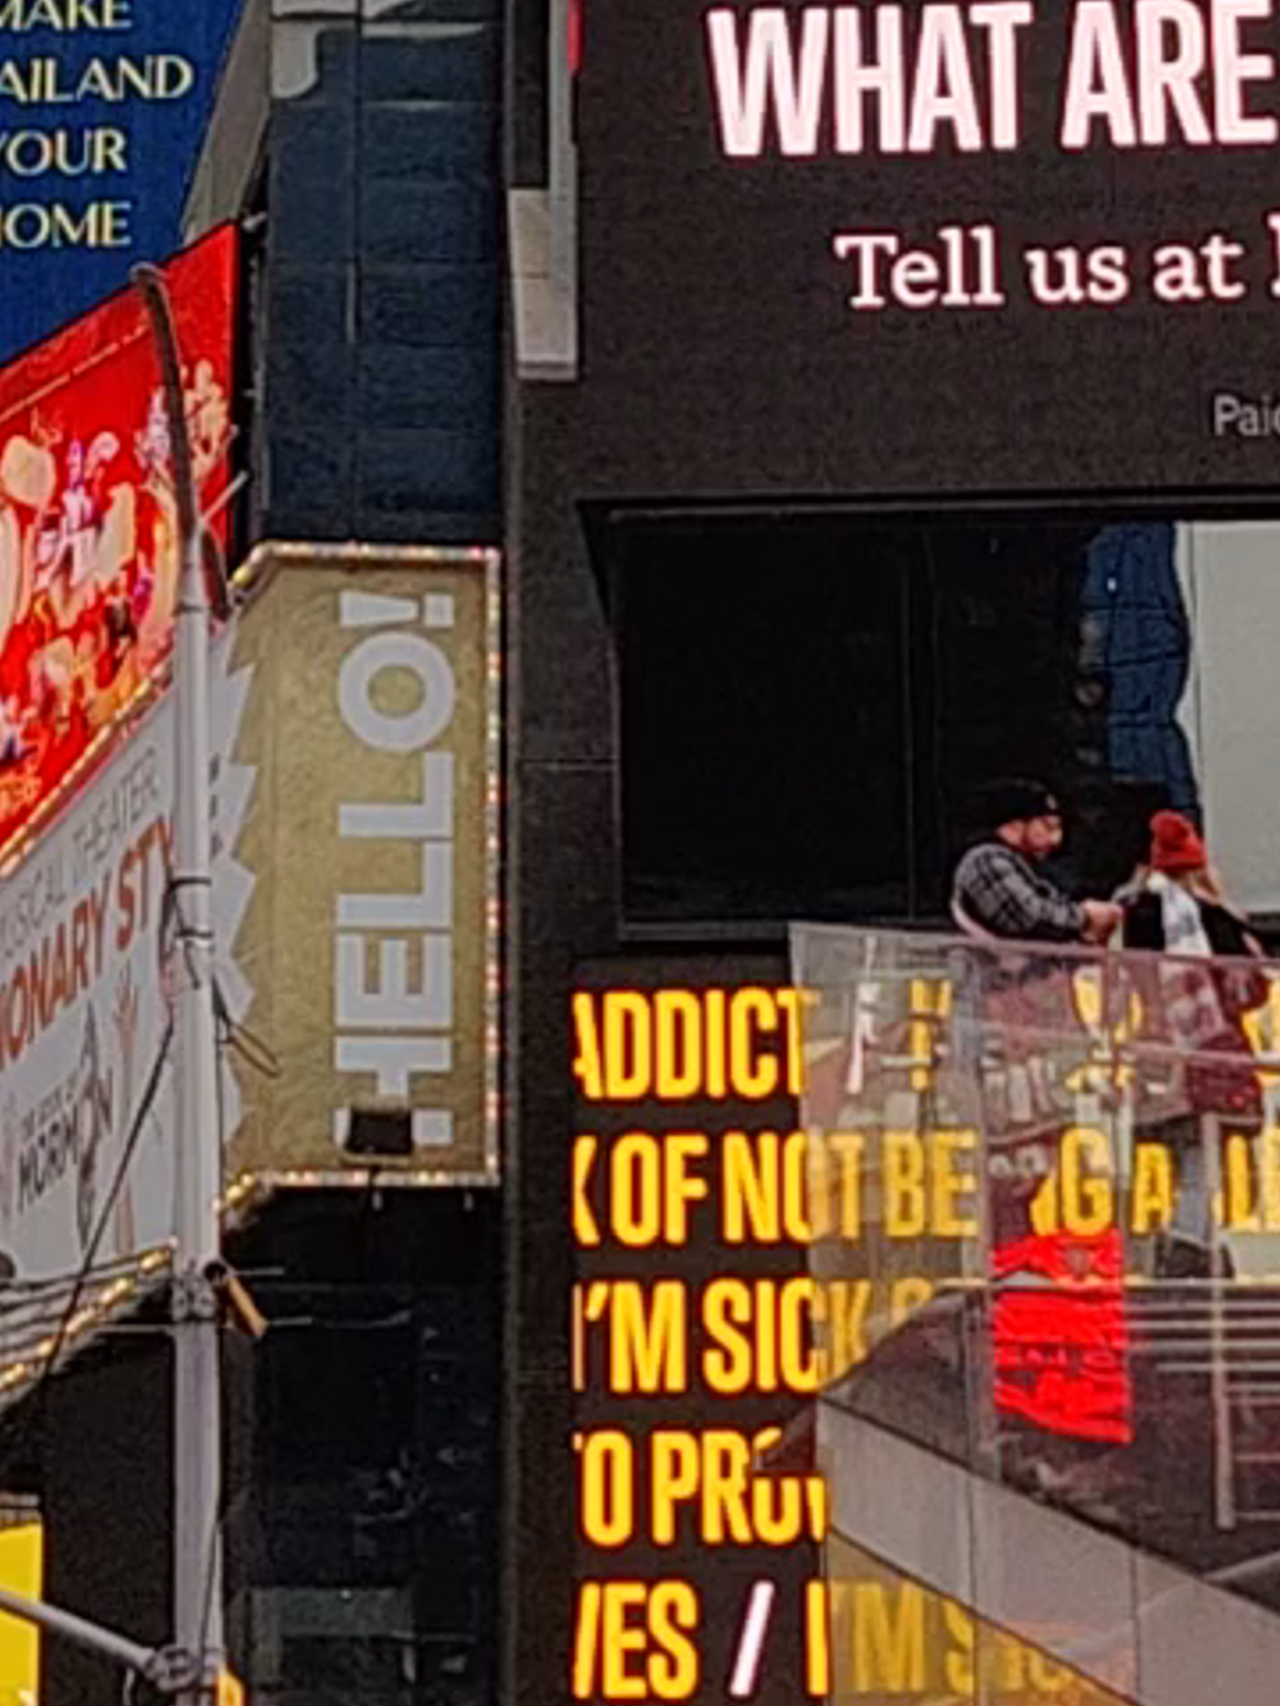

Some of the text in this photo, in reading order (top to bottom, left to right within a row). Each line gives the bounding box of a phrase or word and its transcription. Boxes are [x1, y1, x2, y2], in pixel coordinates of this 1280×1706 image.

[707, 0, 1034, 156] WHAT
[834, 225, 1004, 308] Tell
[1025, 246, 1129, 303] us
[1153, 235, 1245, 301] at
[334, 591, 456, 1146] HELLO!
[611, 1131, 708, 1247] OF
[723, 1128, 862, 1243] NOT
